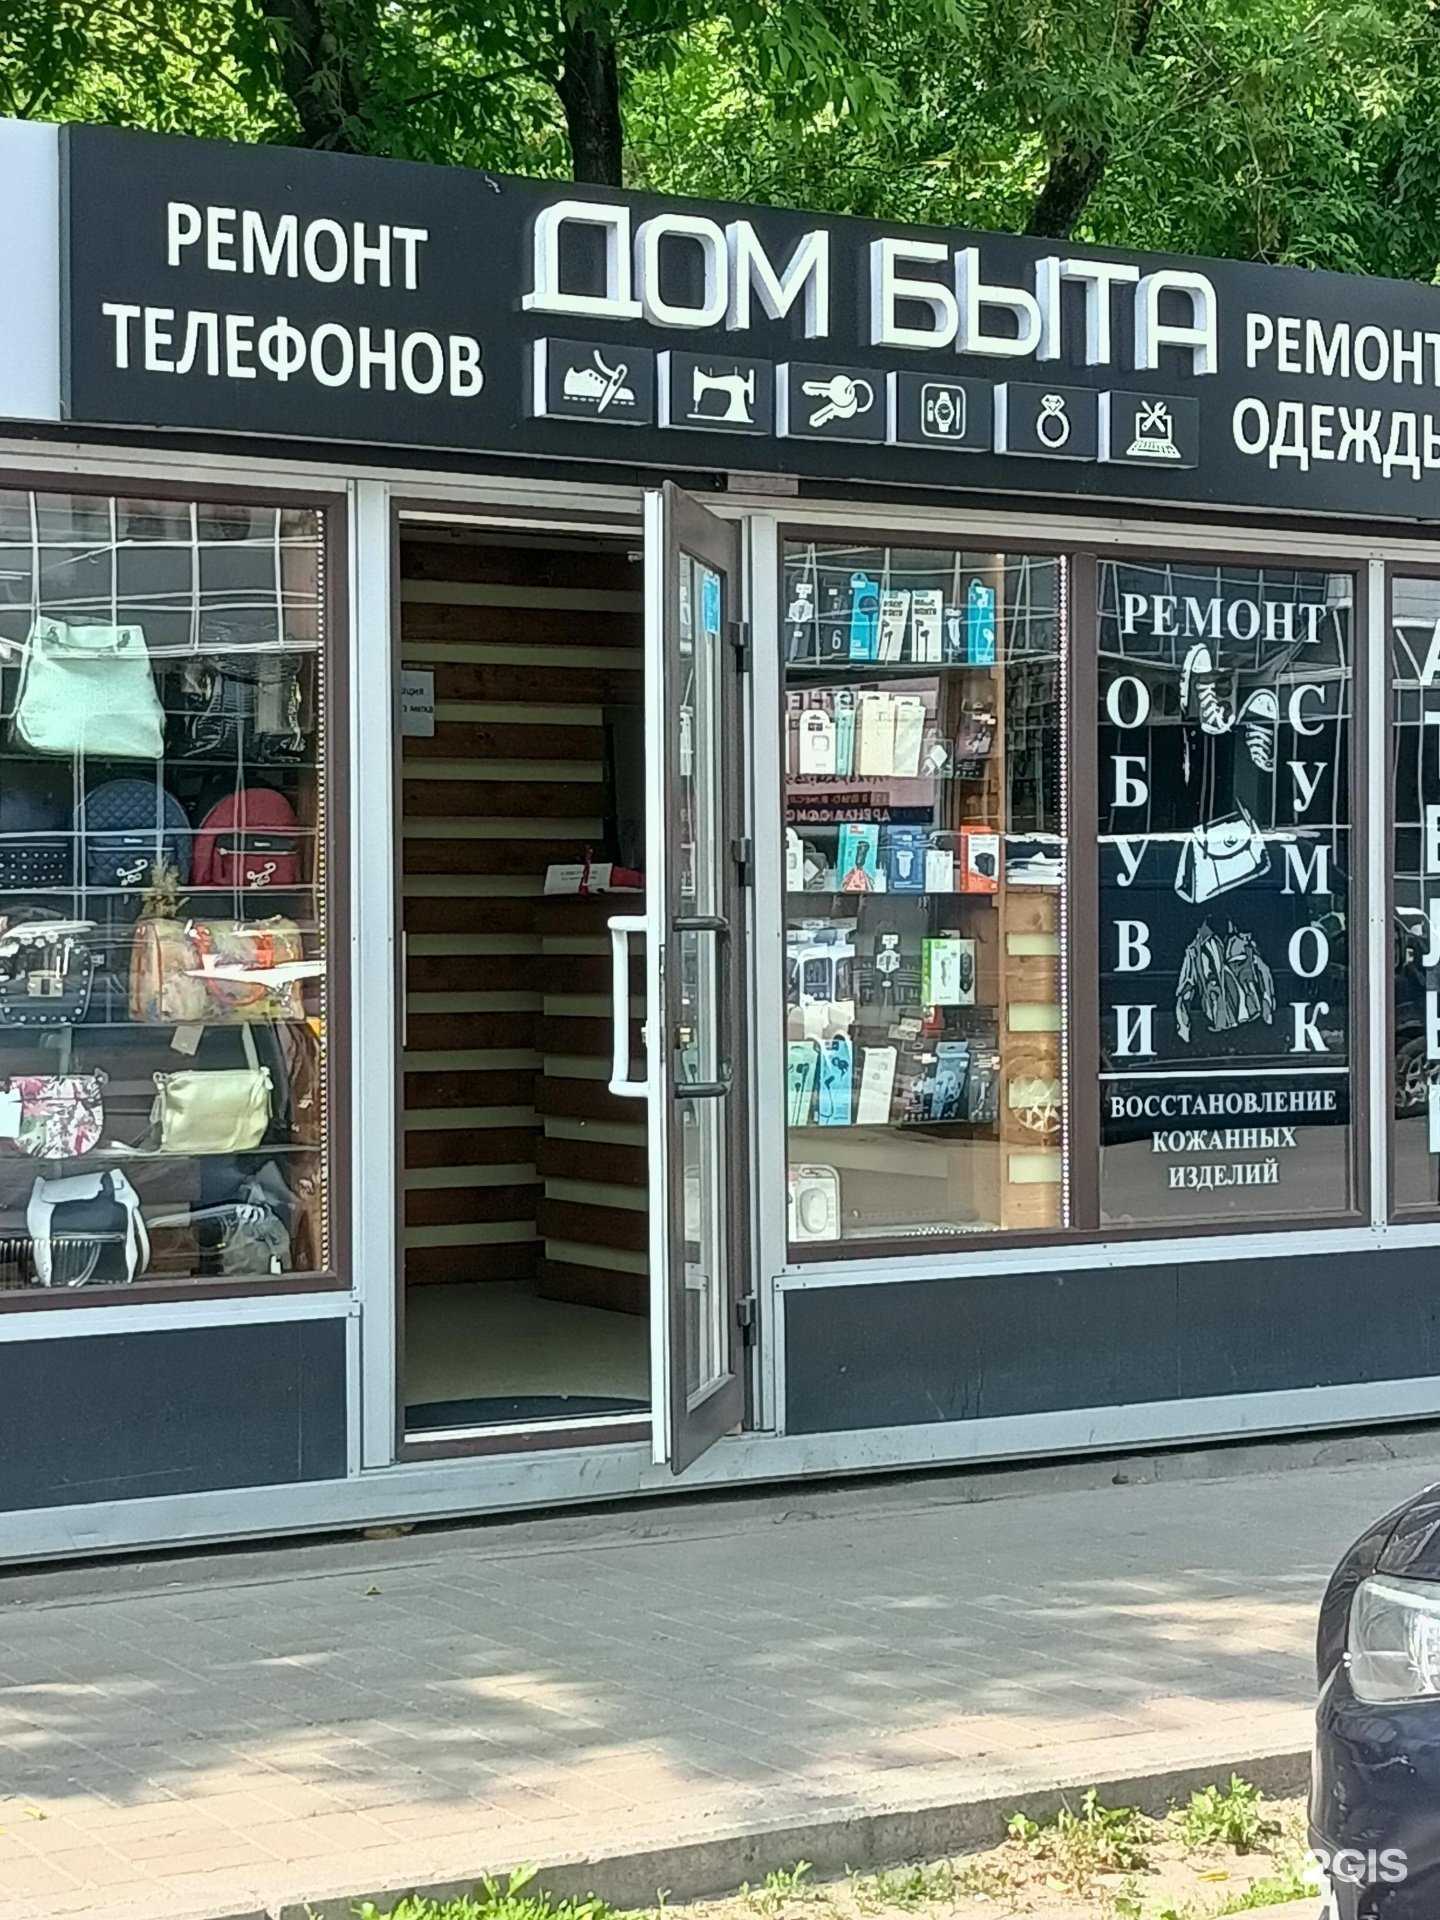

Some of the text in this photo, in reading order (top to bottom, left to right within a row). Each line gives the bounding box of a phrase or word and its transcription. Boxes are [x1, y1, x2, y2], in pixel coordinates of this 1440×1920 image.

[168, 202, 428, 290] РЕМОНТ
[522, 200, 1218, 376] ДОМ БЫТА
[102, 302, 484, 398] ТЕЛЕФОНОВ
[1121, 593, 1327, 643] РЕМОНТ
[1110, 1090, 1336, 1118] ВОССТАНОВЛЕНИЕ
[1152, 1127, 1297, 1152] КОЖАННЫХ
[1168, 1158, 1279, 1191] ИЗДЕЛИЙ
